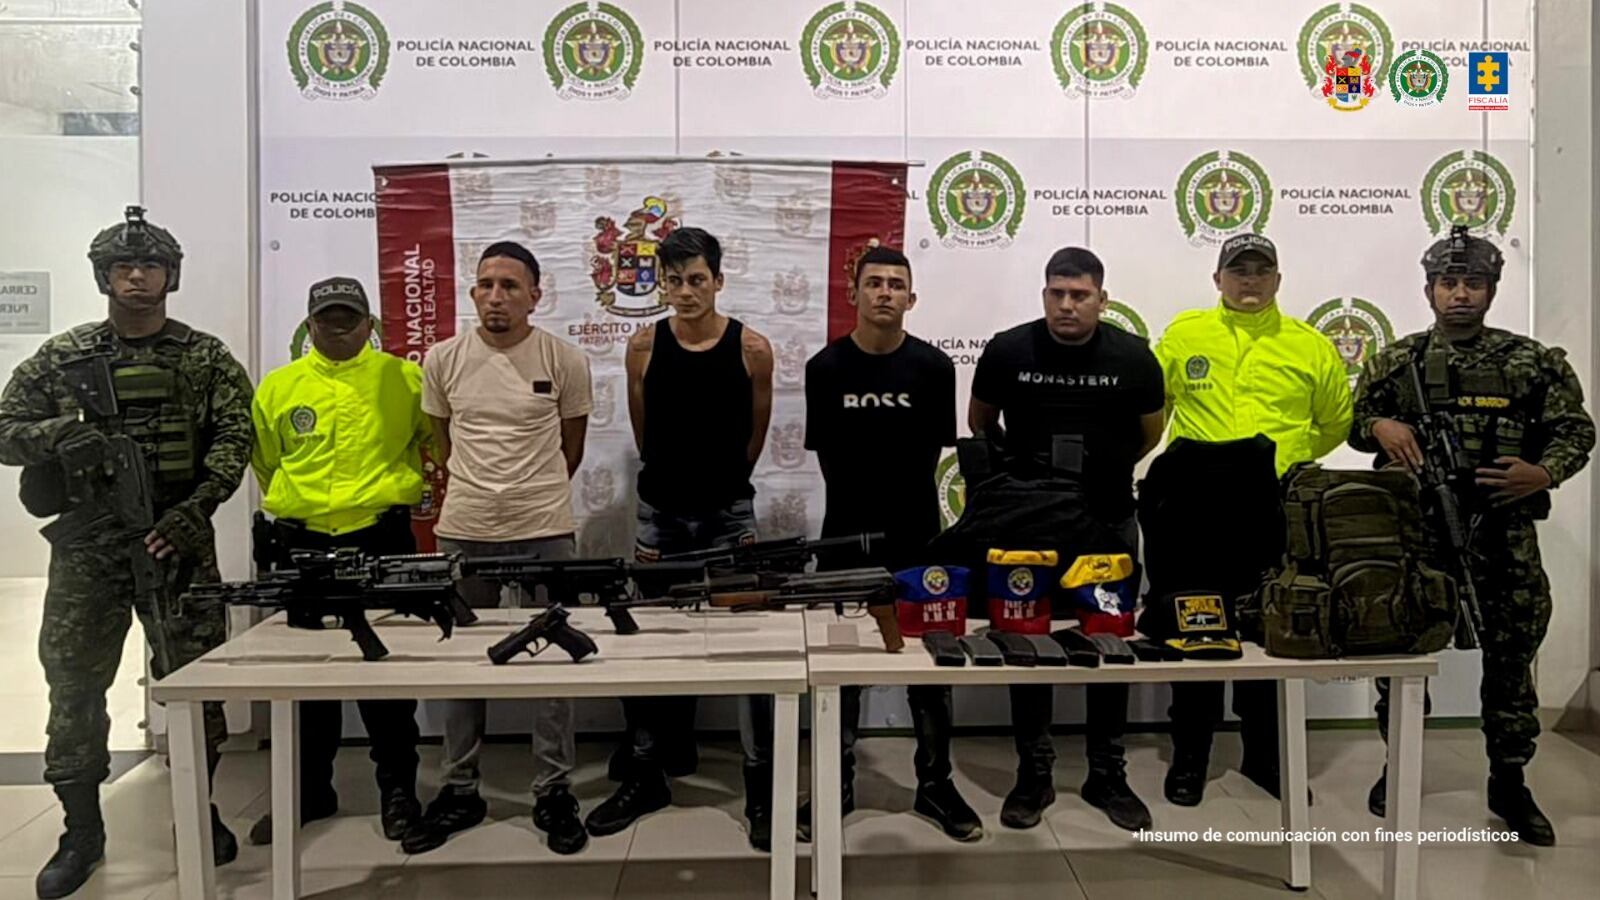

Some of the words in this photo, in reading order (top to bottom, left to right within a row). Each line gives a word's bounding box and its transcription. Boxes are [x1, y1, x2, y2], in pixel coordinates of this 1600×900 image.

[397, 37, 454, 51] POLICÍA
[458, 40, 535, 51] NACIONAL
[654, 38, 711, 51] POLICÍA
[715, 41, 791, 51] NACIONAL
[906, 38, 962, 50] POLICÍA
[966, 41, 1040, 50] NACIONAL
[1155, 39, 1210, 51] POLICÍA
[1214, 42, 1288, 51] NACIONAL
[1402, 39, 1455, 51] POLICÍA
[1460, 41, 1530, 51] NACIONAL
[416, 56, 435, 67] DE
[439, 56, 516, 67] COLOMBIA
[673, 56, 691, 66] DE
[696, 56, 772, 66] COLOMBIA
[925, 55, 943, 66] DE
[947, 55, 1022, 66] COLOMBIA
[1174, 56, 1192, 67] DE
[1196, 56, 1269, 67] COLOMBIA
[270, 190, 328, 203] POLICÍA
[333, 192, 377, 203] NACIO
[1034, 187, 1089, 200] POLICÍA
[1093, 190, 1167, 200] NACIONAL
[1281, 186, 1335, 199] POLICÍA
[1340, 189, 1411, 199] NACIONAL
[290, 208, 308, 218] DE
[313, 208, 375, 218] COLOMB
[1052, 205, 1070, 215] DE
[1074, 205, 1149, 215] COLOMBIA
[1299, 204, 1317, 214] DE
[1320, 204, 1393, 214] COLOMBIA
[404, 244, 422, 346] NACIONAL
[423, 259, 436, 320] LEALTAD
[568, 320, 631, 336] EJÉRCITO
[1018, 371, 1119, 386] MONASTERY
